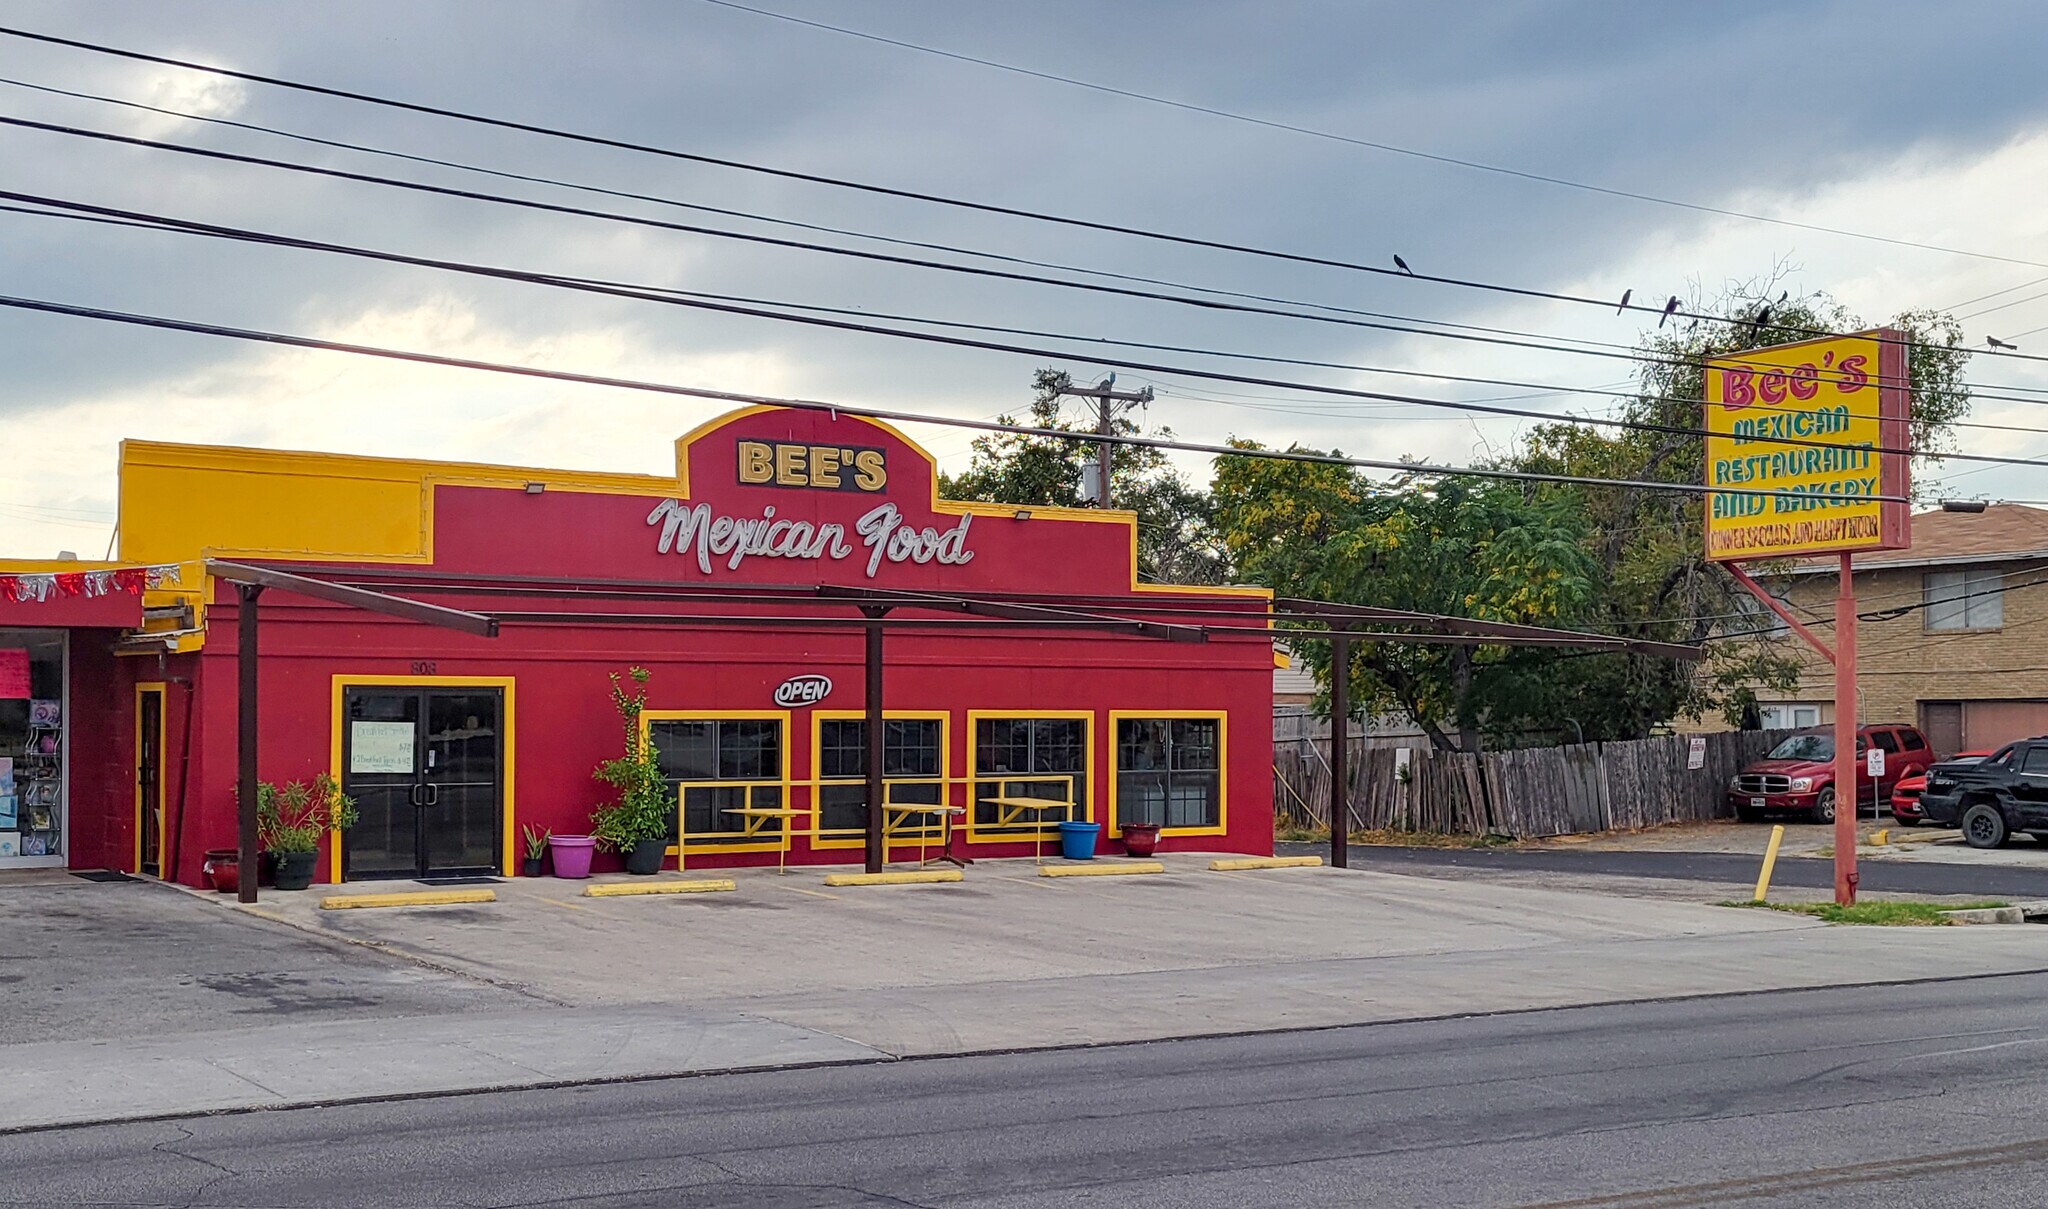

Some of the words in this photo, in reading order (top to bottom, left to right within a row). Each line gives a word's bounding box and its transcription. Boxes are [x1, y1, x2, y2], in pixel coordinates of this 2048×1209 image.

[1721, 351, 1868, 411] Bee's
[1733, 405, 1850, 446] MEXICAN
[738, 441, 887, 491] BEE'S
[1715, 441, 1873, 484] RESTAURANT
[1712, 488, 1766, 520] AND
[1774, 477, 1877, 514] BAKERY
[647, 498, 852, 574] Mexican
[856, 502, 975, 578] Food
[1793, 521, 1813, 545] AND
[1814, 517, 1847, 542] HAPPY
[777, 680, 828, 702] OPEN
